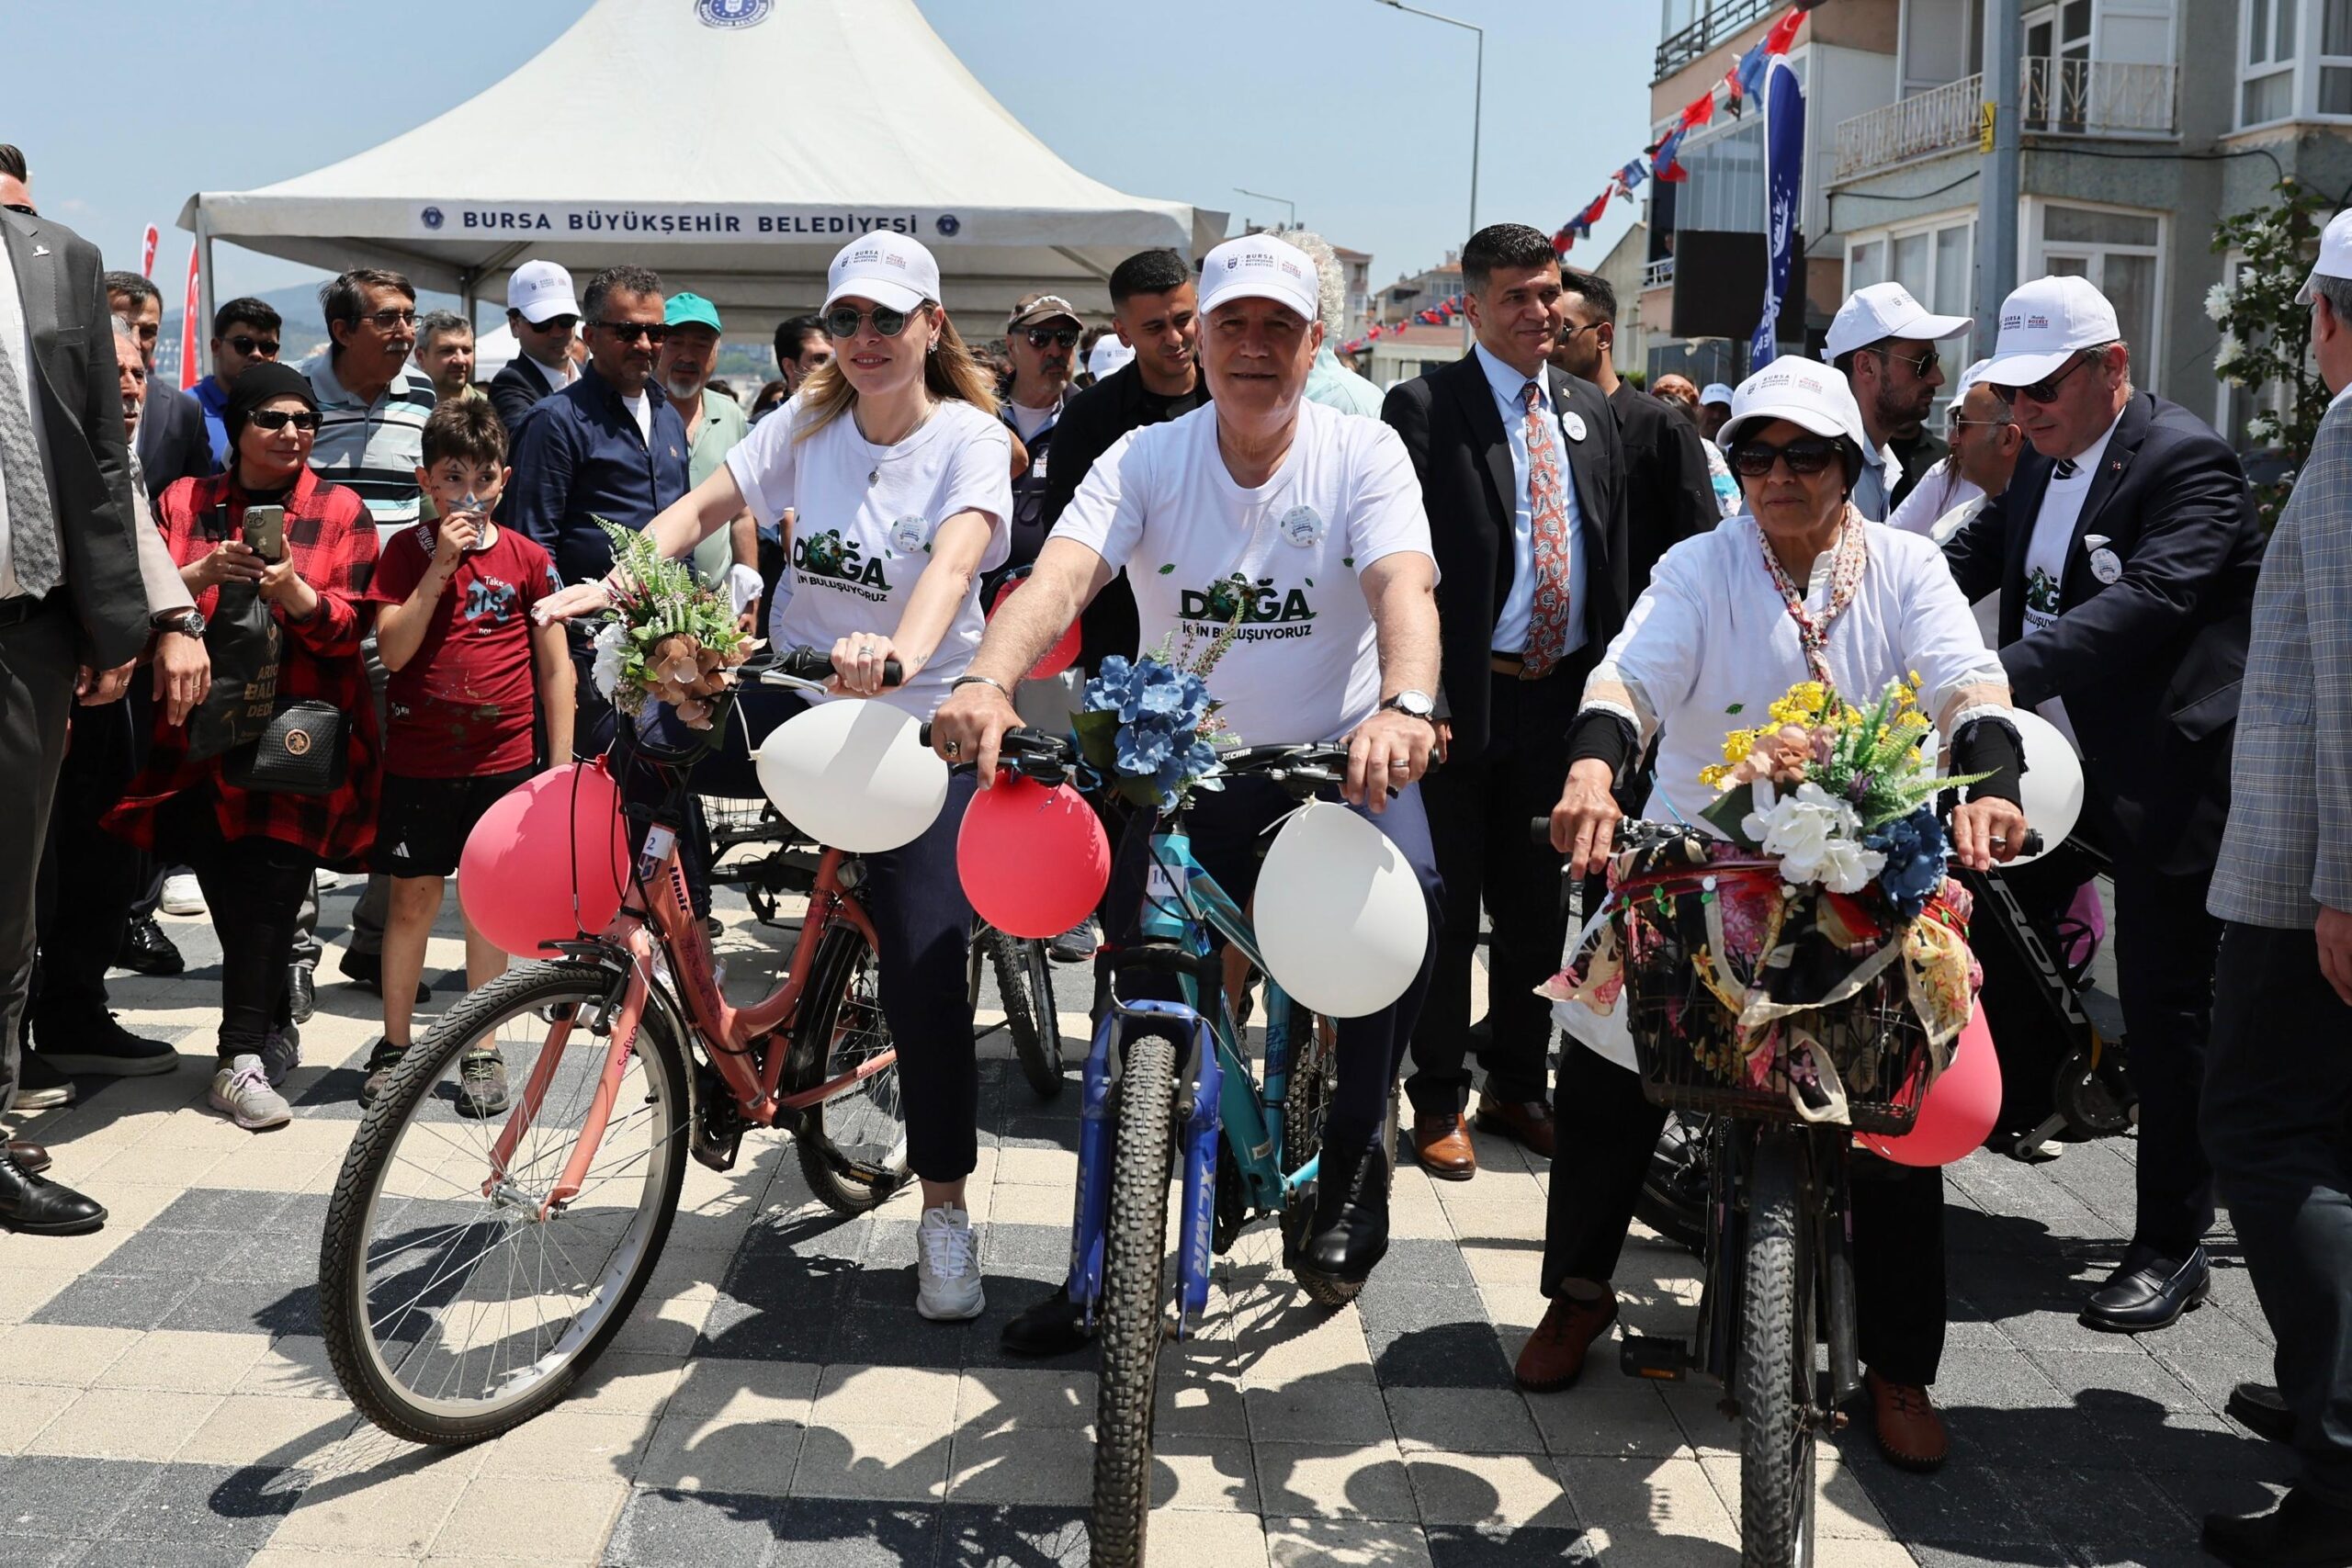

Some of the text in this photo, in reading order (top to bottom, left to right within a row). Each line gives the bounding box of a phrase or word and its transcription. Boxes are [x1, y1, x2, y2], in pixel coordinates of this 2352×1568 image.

[463, 211, 918, 234] BURSA BÜYÜKŞEHİR BELEDİYESİ
[484, 575, 504, 587] Take
[809, 577, 888, 602] BULUŞUYORUZ
[1181, 578, 1311, 622] DOĞA
[1212, 625, 1312, 643] BUŞUYORUZ
[1222, 748, 1252, 761] XCMR
[646, 837, 656, 851] 2
[1984, 869, 2087, 1025] RON
[617, 1025, 639, 1066] Safiro
